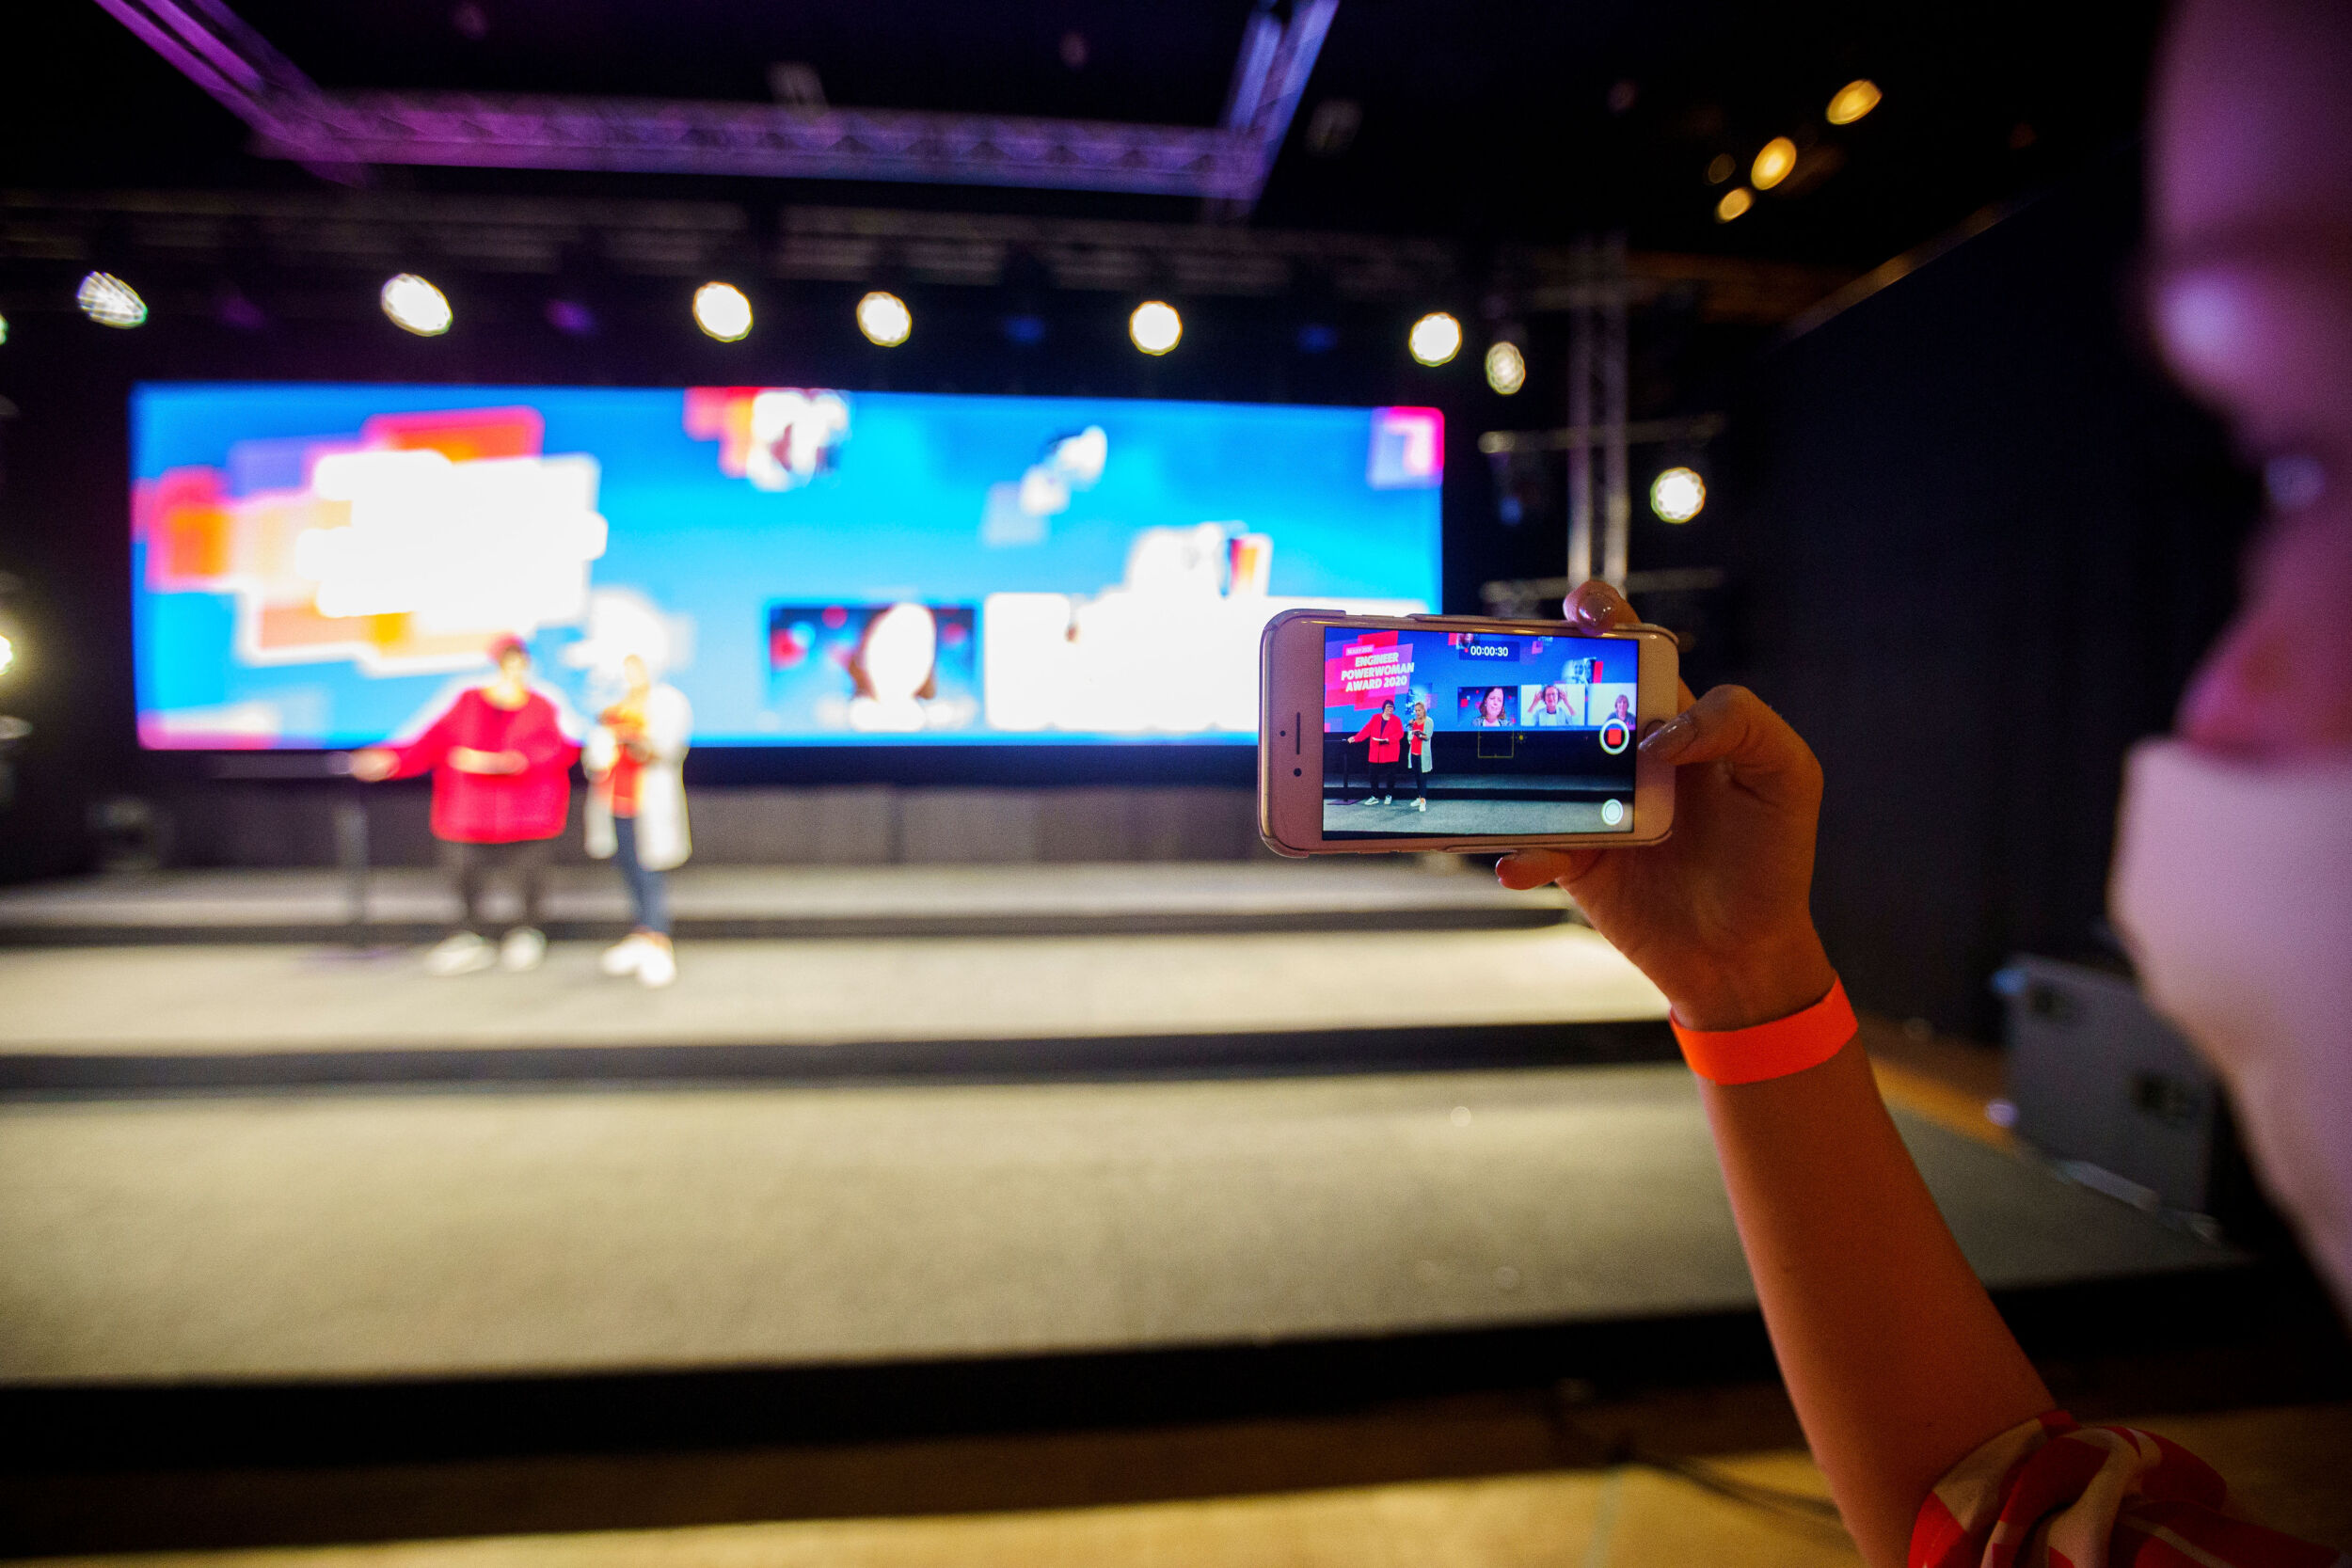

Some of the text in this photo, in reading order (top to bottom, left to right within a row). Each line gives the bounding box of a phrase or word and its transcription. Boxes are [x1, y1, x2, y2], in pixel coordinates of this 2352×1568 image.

[1470, 645, 1509, 657] 00:00:30
[1355, 652, 1399, 667] ENGINEER
[1341, 662, 1415, 681] POWERWOMAN
[1345, 675, 1408, 692] AWARD 2020
